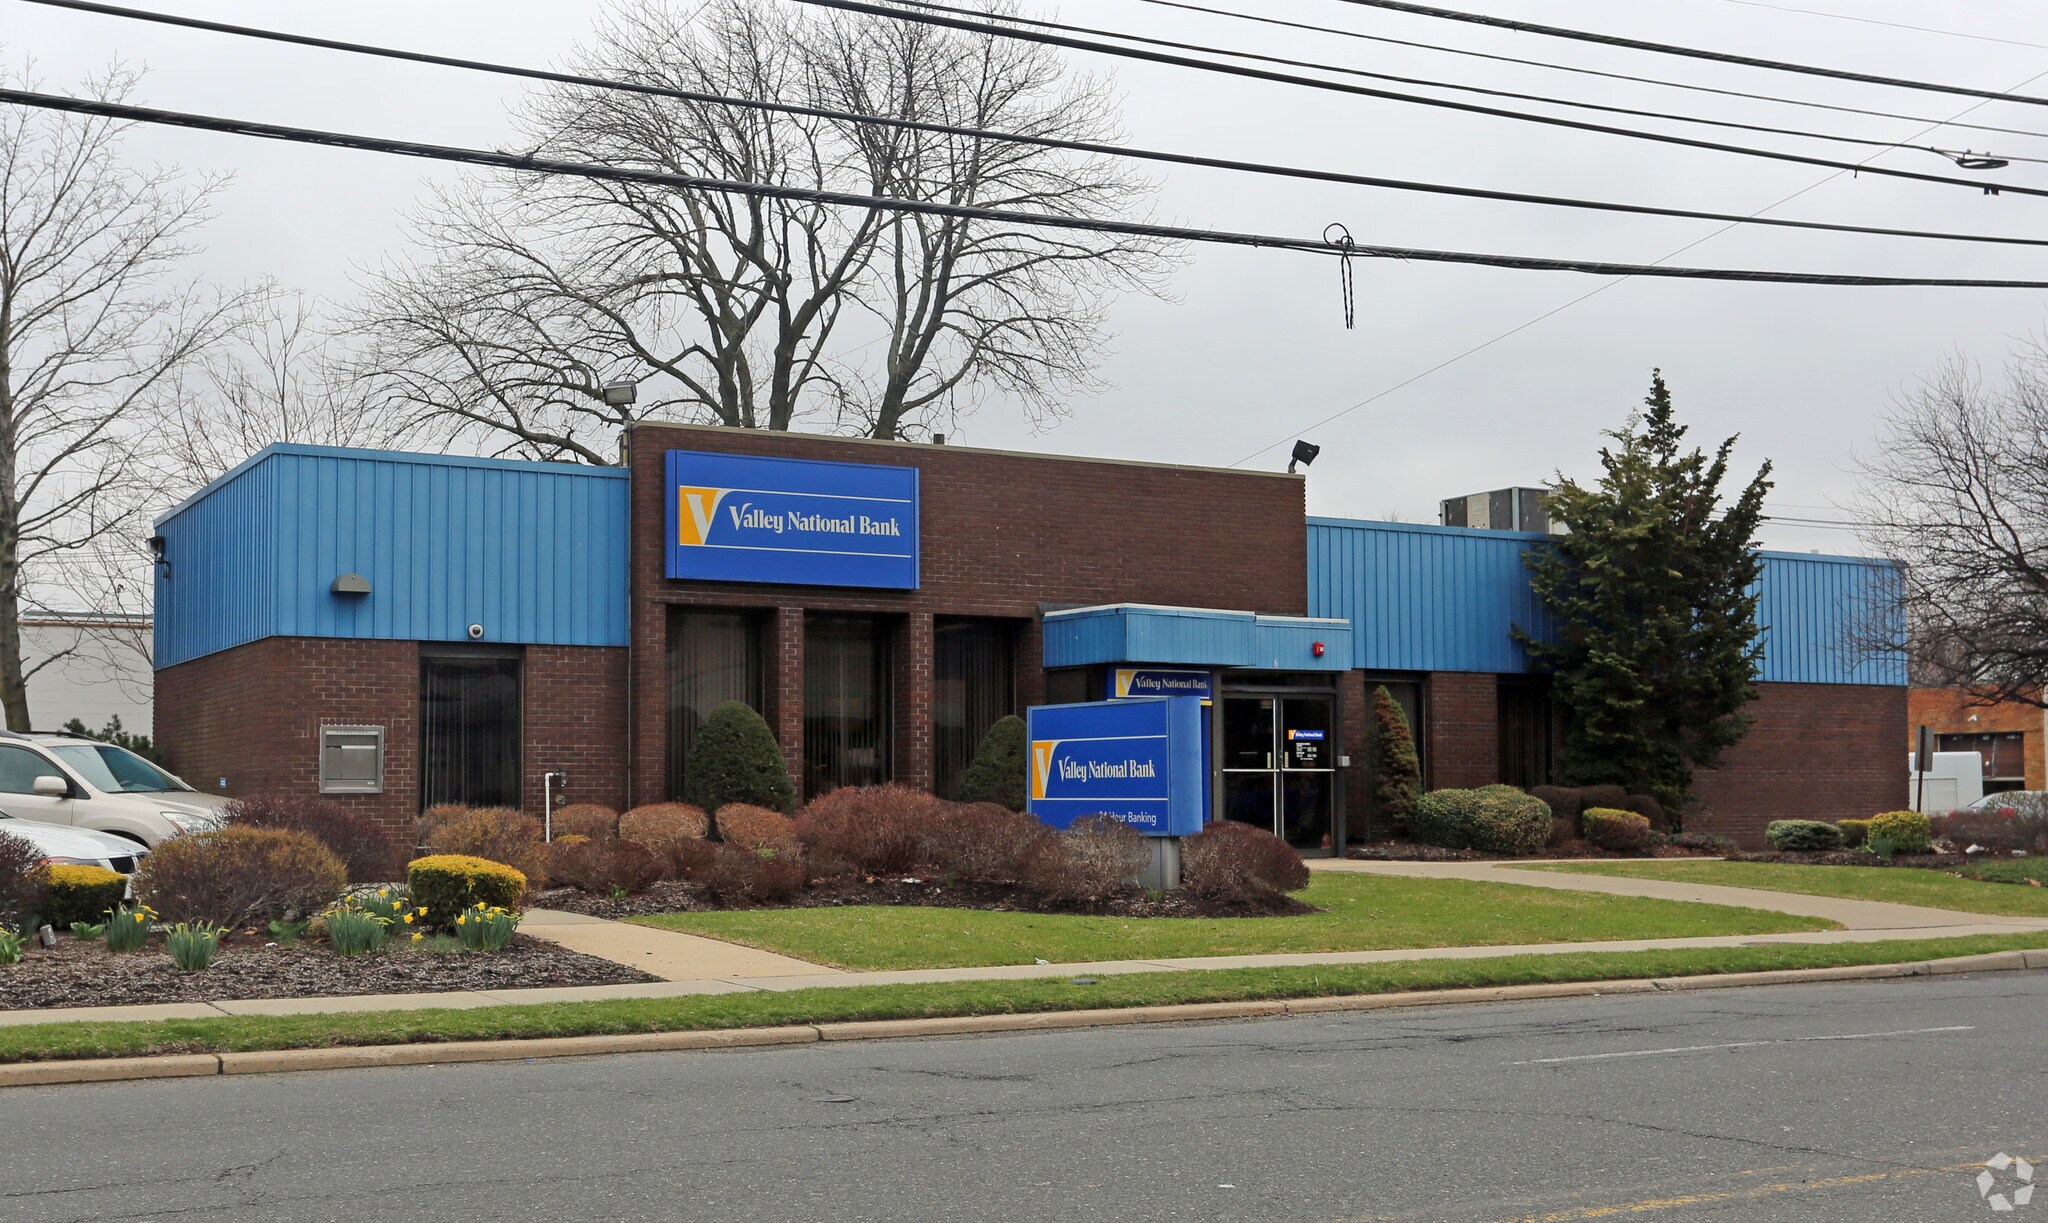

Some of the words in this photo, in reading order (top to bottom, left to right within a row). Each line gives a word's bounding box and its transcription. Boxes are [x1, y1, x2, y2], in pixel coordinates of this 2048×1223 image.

[729, 502, 784, 534] Valley
[787, 511, 855, 534] National
[859, 515, 901, 537] Bank
[1136, 676, 1161, 690] Valley
[1162, 678, 1192, 689] National
[1192, 679, 1208, 689] Bank
[1058, 755, 1087, 783] Valley
[1088, 760, 1128, 779] National
[1129, 759, 1156, 778] Bank
[1127, 811, 1157, 826] Banking
